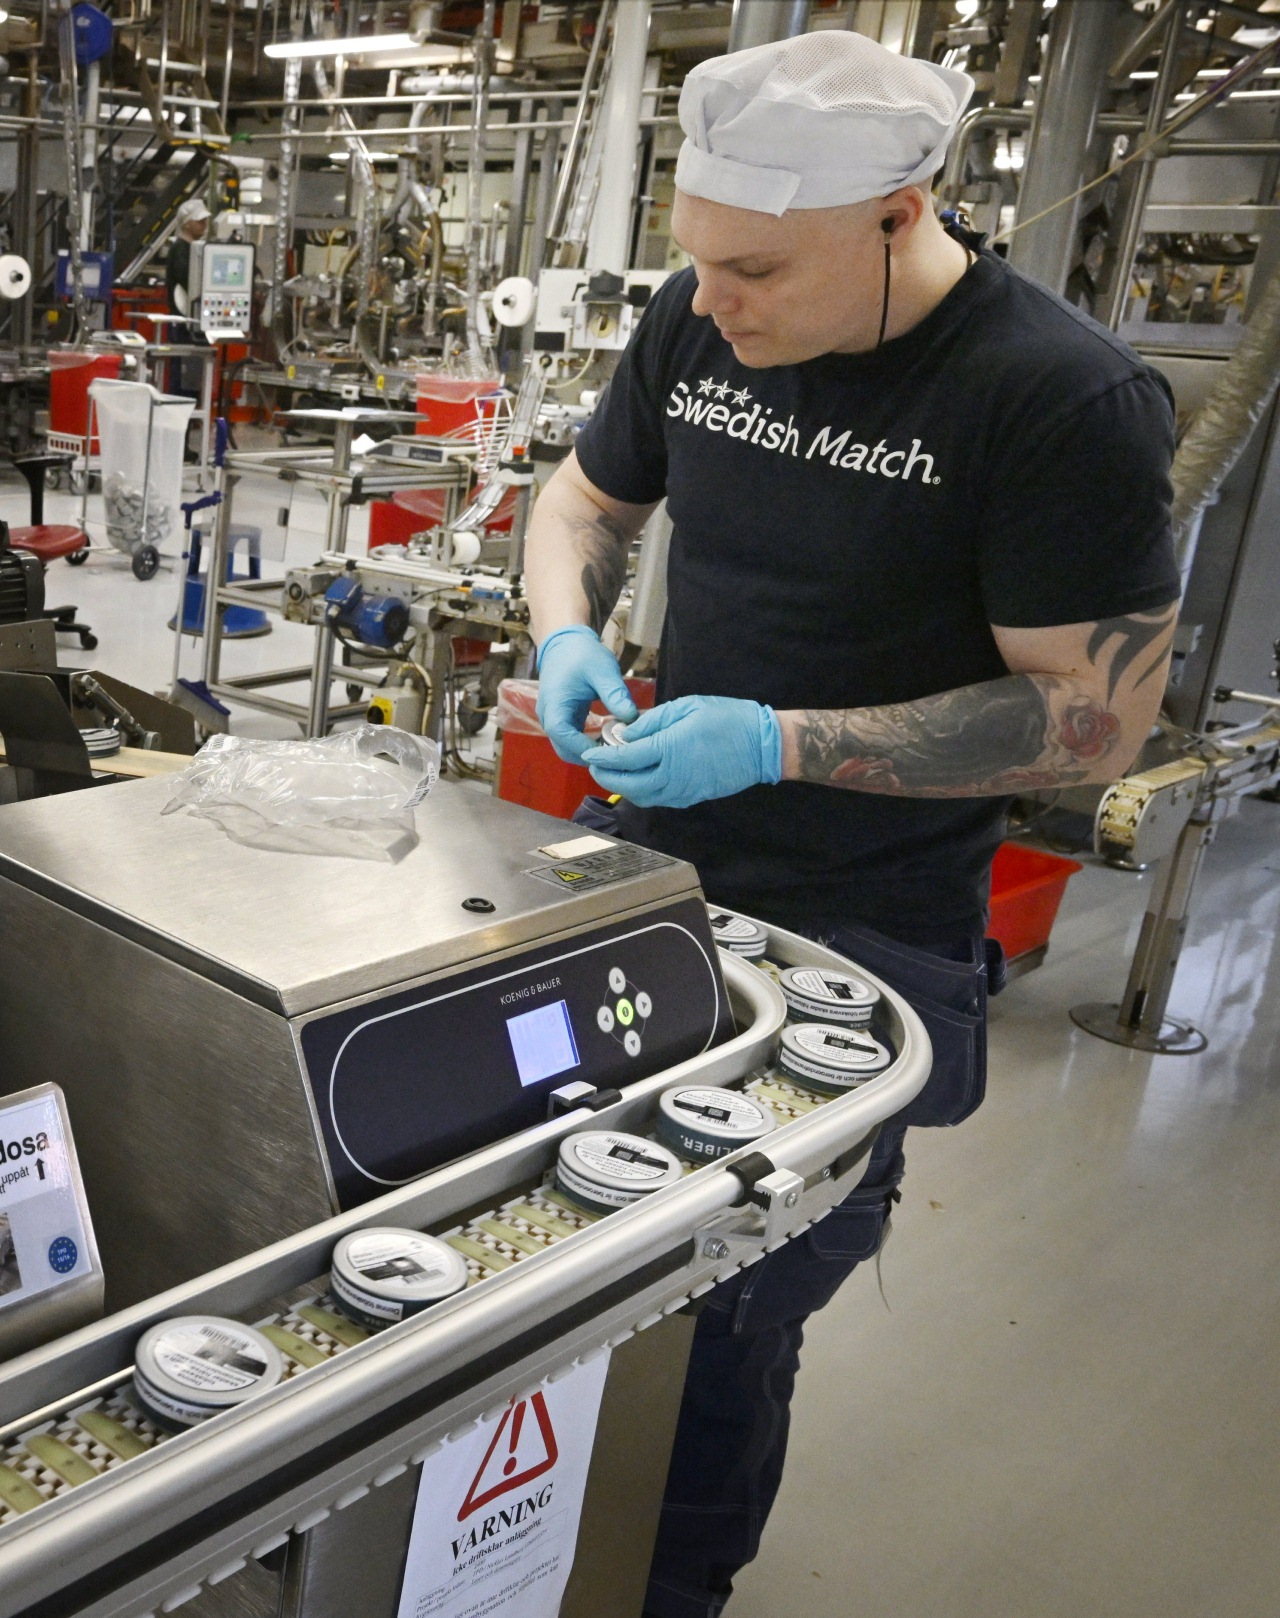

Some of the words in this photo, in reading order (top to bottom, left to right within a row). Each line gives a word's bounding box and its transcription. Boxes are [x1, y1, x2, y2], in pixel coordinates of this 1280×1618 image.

[666, 381, 800, 457] Swedish
[499, 987, 530, 1006] KOENIG
[531, 985, 537, 996] &
[536, 977, 562, 994] BAUER
[680, 1134, 736, 1157] LIBER.
[1, 1165, 30, 1190] uppåt
[450, 1482, 554, 1561] VARNING
[452, 1562, 468, 1577] Icke
[468, 1540, 504, 1566] driftsklar
[505, 1517, 543, 1546] anläggning
